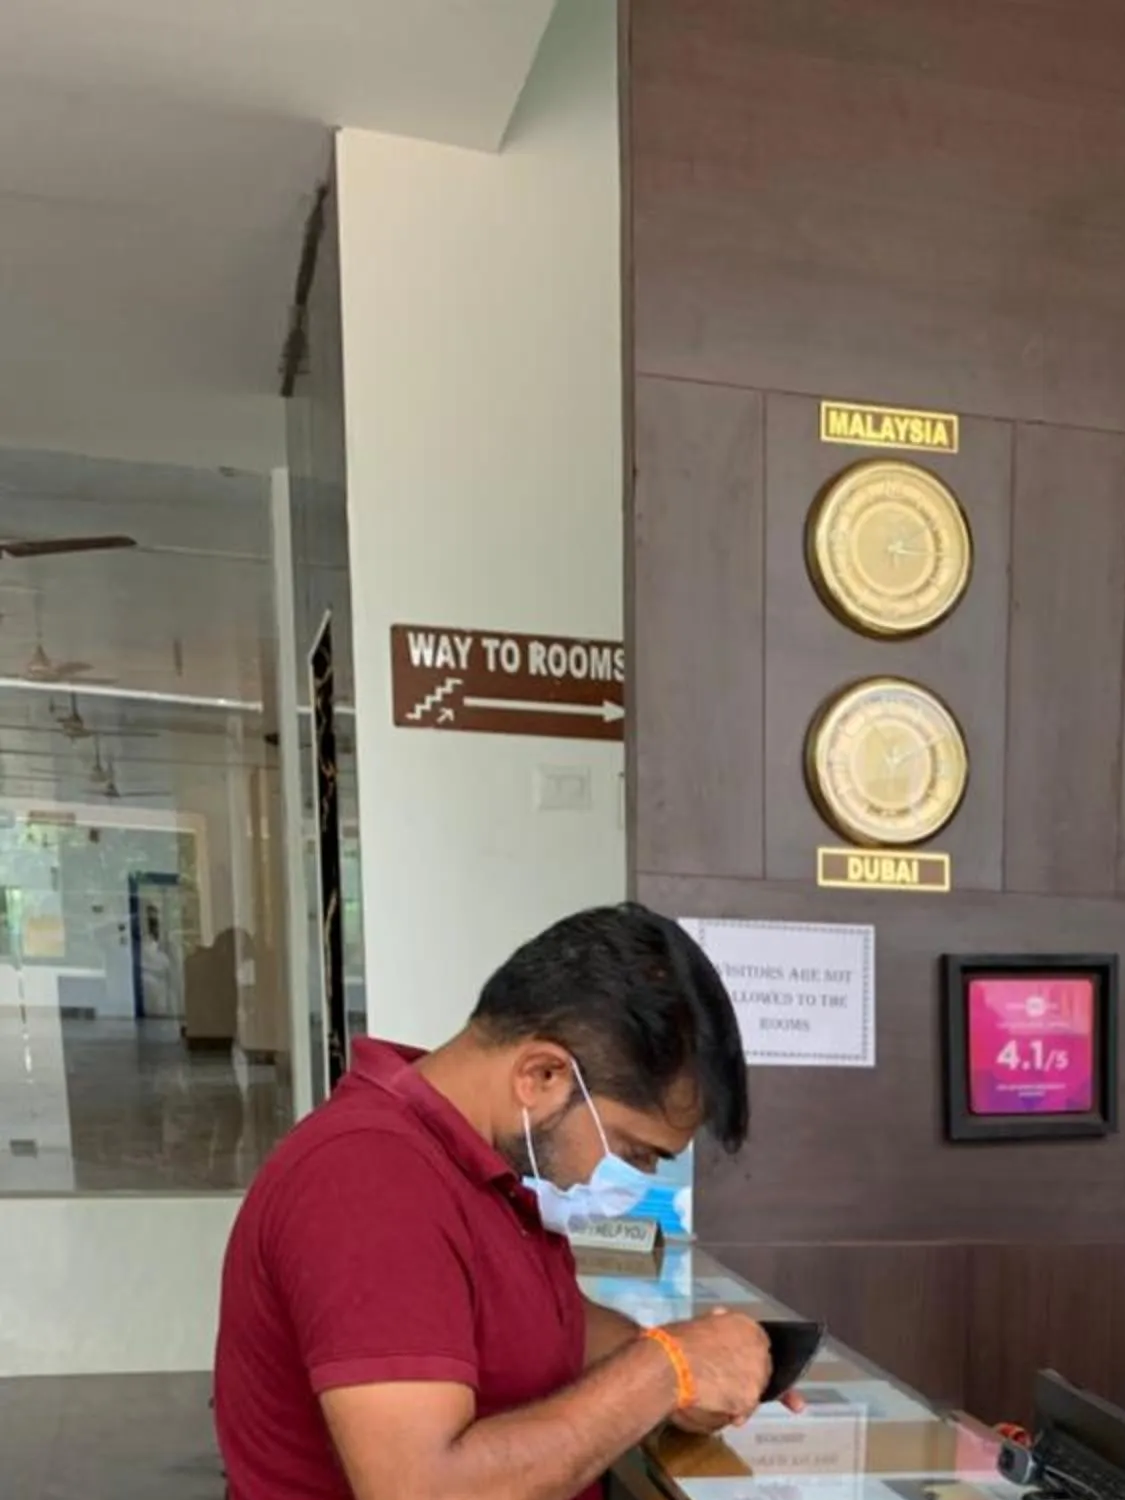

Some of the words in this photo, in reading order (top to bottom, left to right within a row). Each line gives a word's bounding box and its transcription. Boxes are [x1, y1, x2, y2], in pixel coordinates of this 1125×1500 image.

[828, 409, 949, 446] MALAYSIA
[408, 631, 473, 670] WAY
[481, 637, 521, 674] TO
[528, 640, 624, 682] ROOMS
[848, 856, 919, 884] DUBAI
[788, 967, 821, 982] ARE
[731, 989, 793, 1006] LLOWED
[795, 993, 816, 1007] TO
[820, 994, 848, 1009] THE
[759, 1017, 811, 1032] ROOMS
[996, 1039, 1069, 1072] 4.1/5
